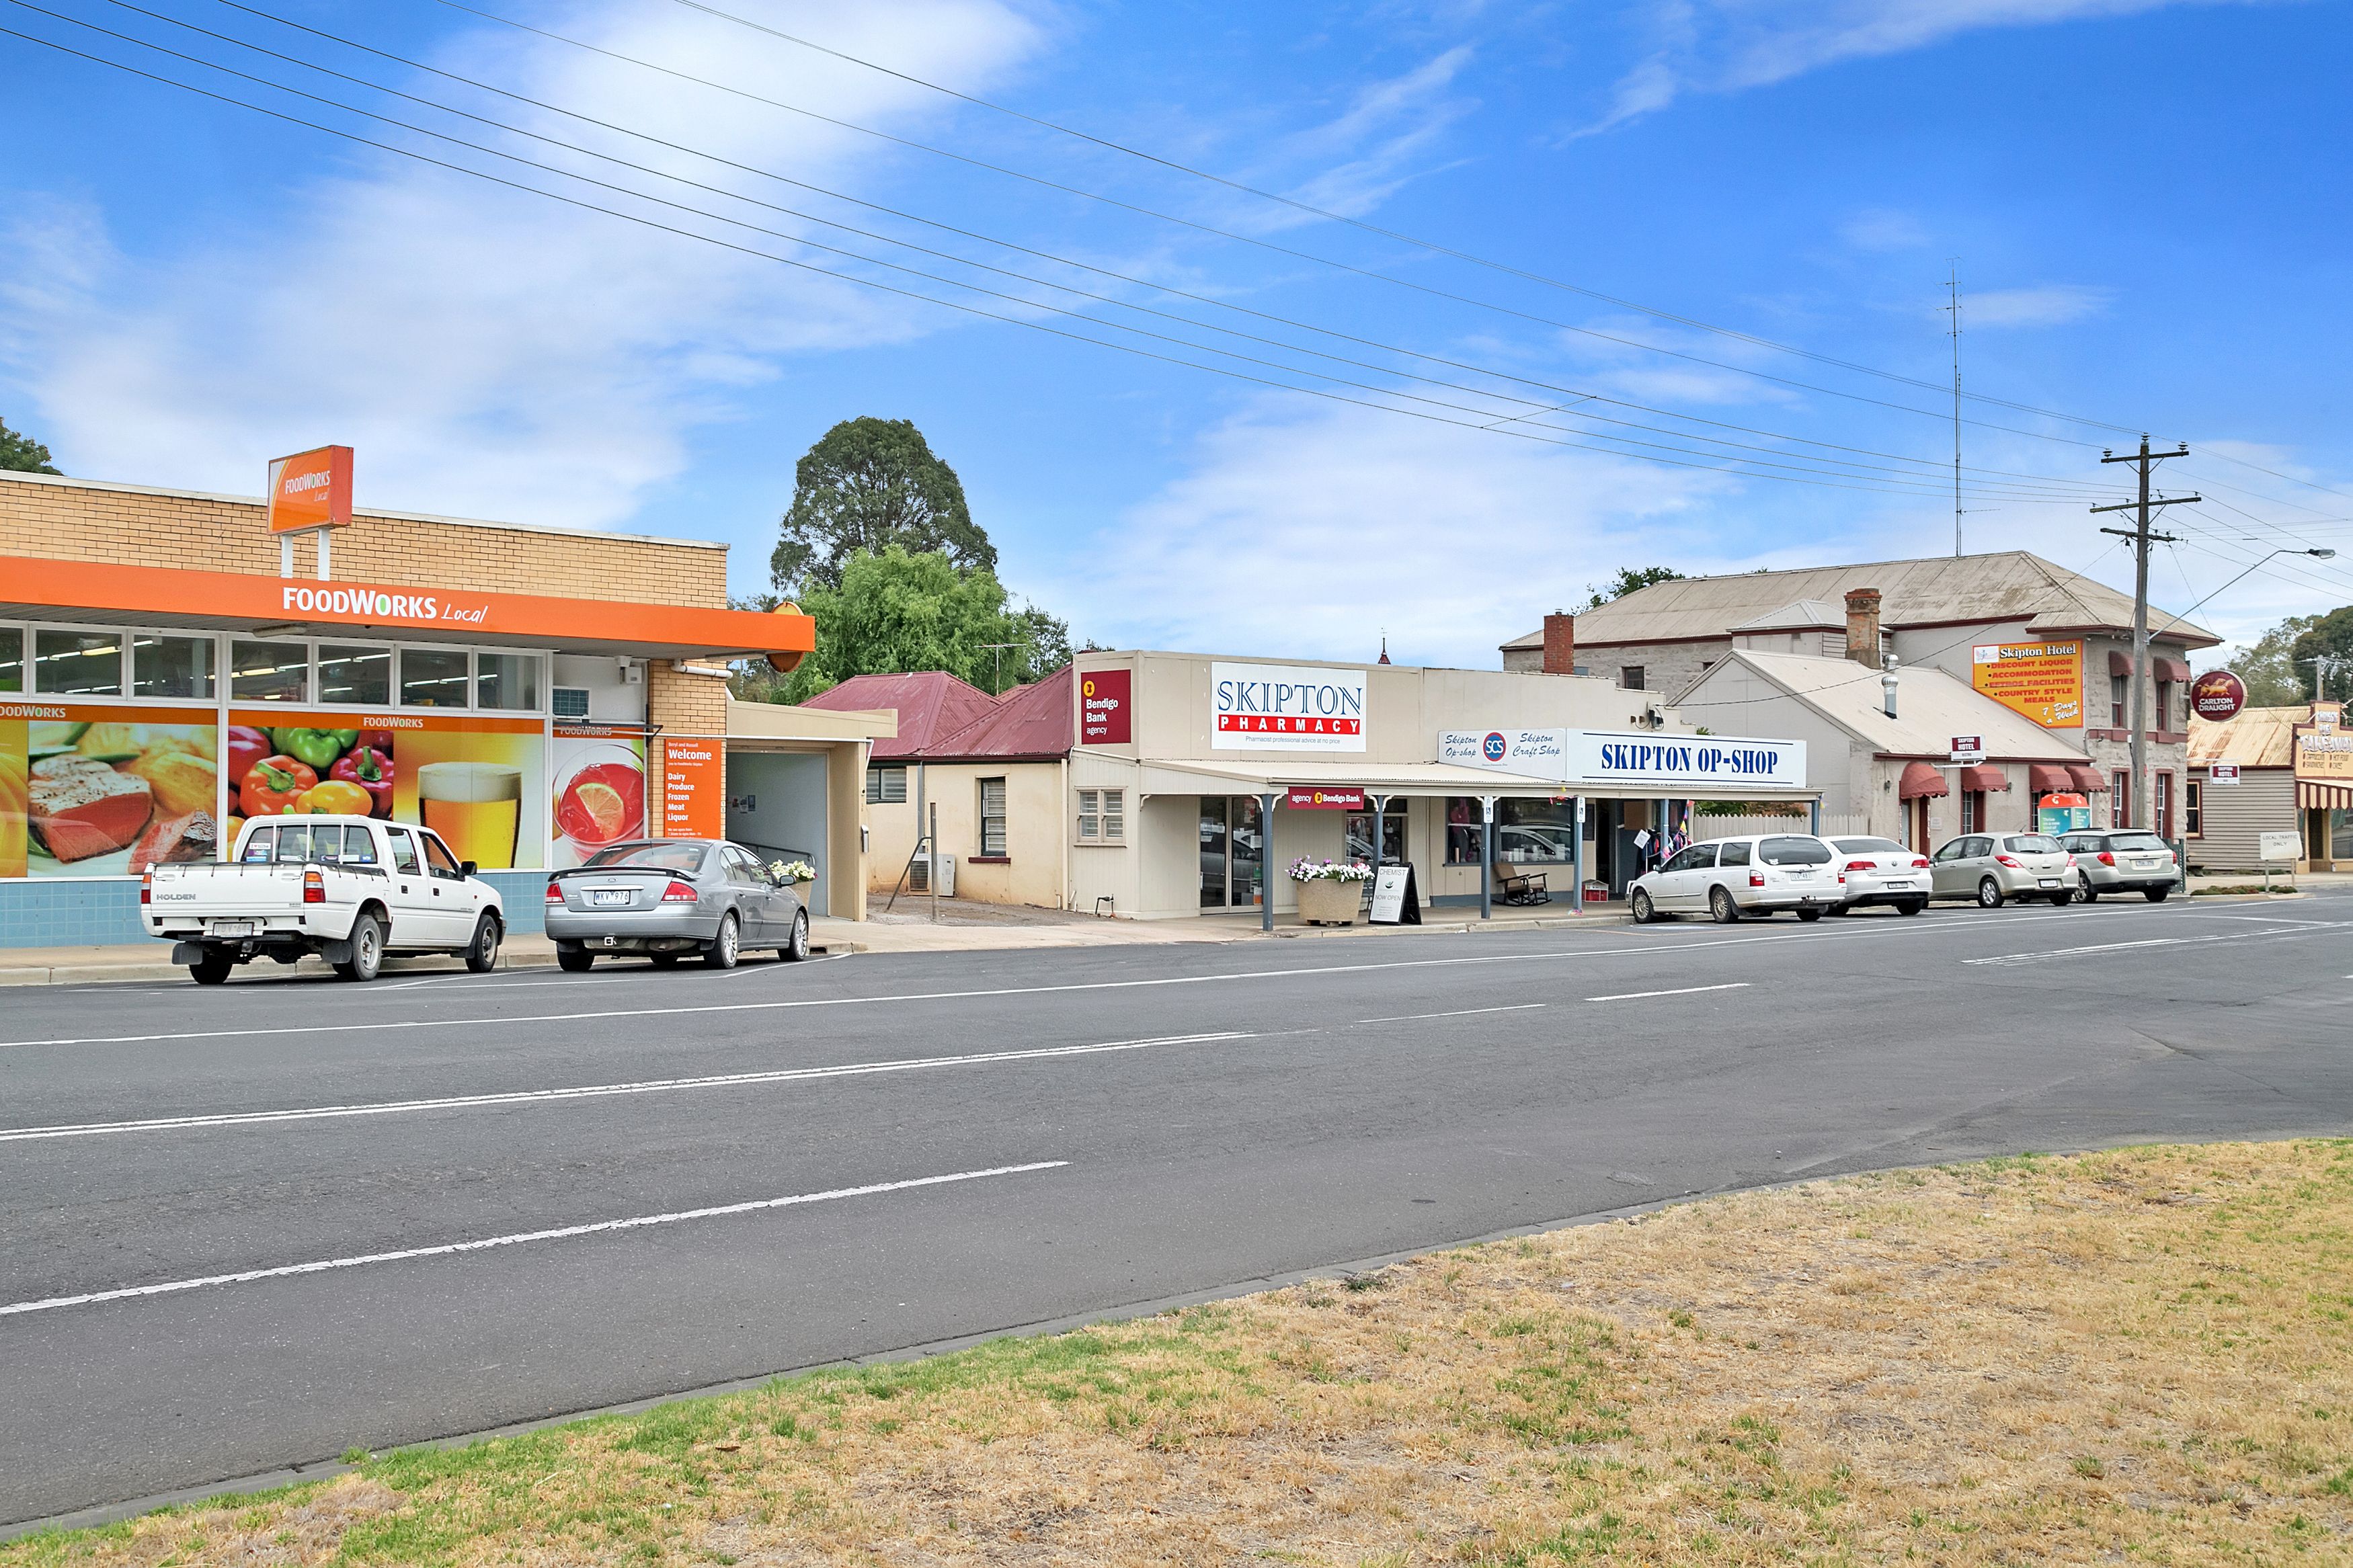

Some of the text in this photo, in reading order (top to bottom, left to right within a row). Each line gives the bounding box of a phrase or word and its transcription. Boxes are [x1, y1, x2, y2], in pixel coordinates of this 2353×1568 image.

[285, 470, 330, 494] FOODWORKS
[314, 487, 330, 501] Local
[283, 587, 488, 624] FOODWORKS Local
[2000, 644, 2076, 659] Skipton Hotel
[1991, 659, 2073, 669] DISCOUNT LIQUOR
[1992, 669, 2073, 679] ACCOMMODATION
[2027, 678, 2075, 686] FACILITIES
[1217, 681, 1363, 715] SKIPTON
[1998, 689, 2040, 697] COUNTRY
[1086, 698, 1119, 710] Bendigo
[2042, 700, 2077, 716] 7 Days
[1086, 712, 1107, 723] Bank
[2055, 707, 2079, 720] Week
[364, 716, 424, 728] FOODWORKS
[1220, 716, 1359, 733] PHARMACY
[1086, 727, 1107, 736] agency
[1445, 735, 1477, 747] Skipton
[1520, 733, 1554, 744] Skipton
[1445, 747, 1476, 758] Op-shop
[1486, 740, 1505, 753] SCS
[1513, 745, 1560, 757] Craft Shop
[668, 748, 712, 760] Welcome
[1601, 743, 1778, 774] SKIPTON OP-SHOP
[668, 772, 686, 782] Dairy
[668, 782, 694, 790] Produce
[1291, 794, 1360, 804] agency Bendigo Bank
[668, 813, 688, 822] Liquor
[596, 892, 629, 901] WKV 976
